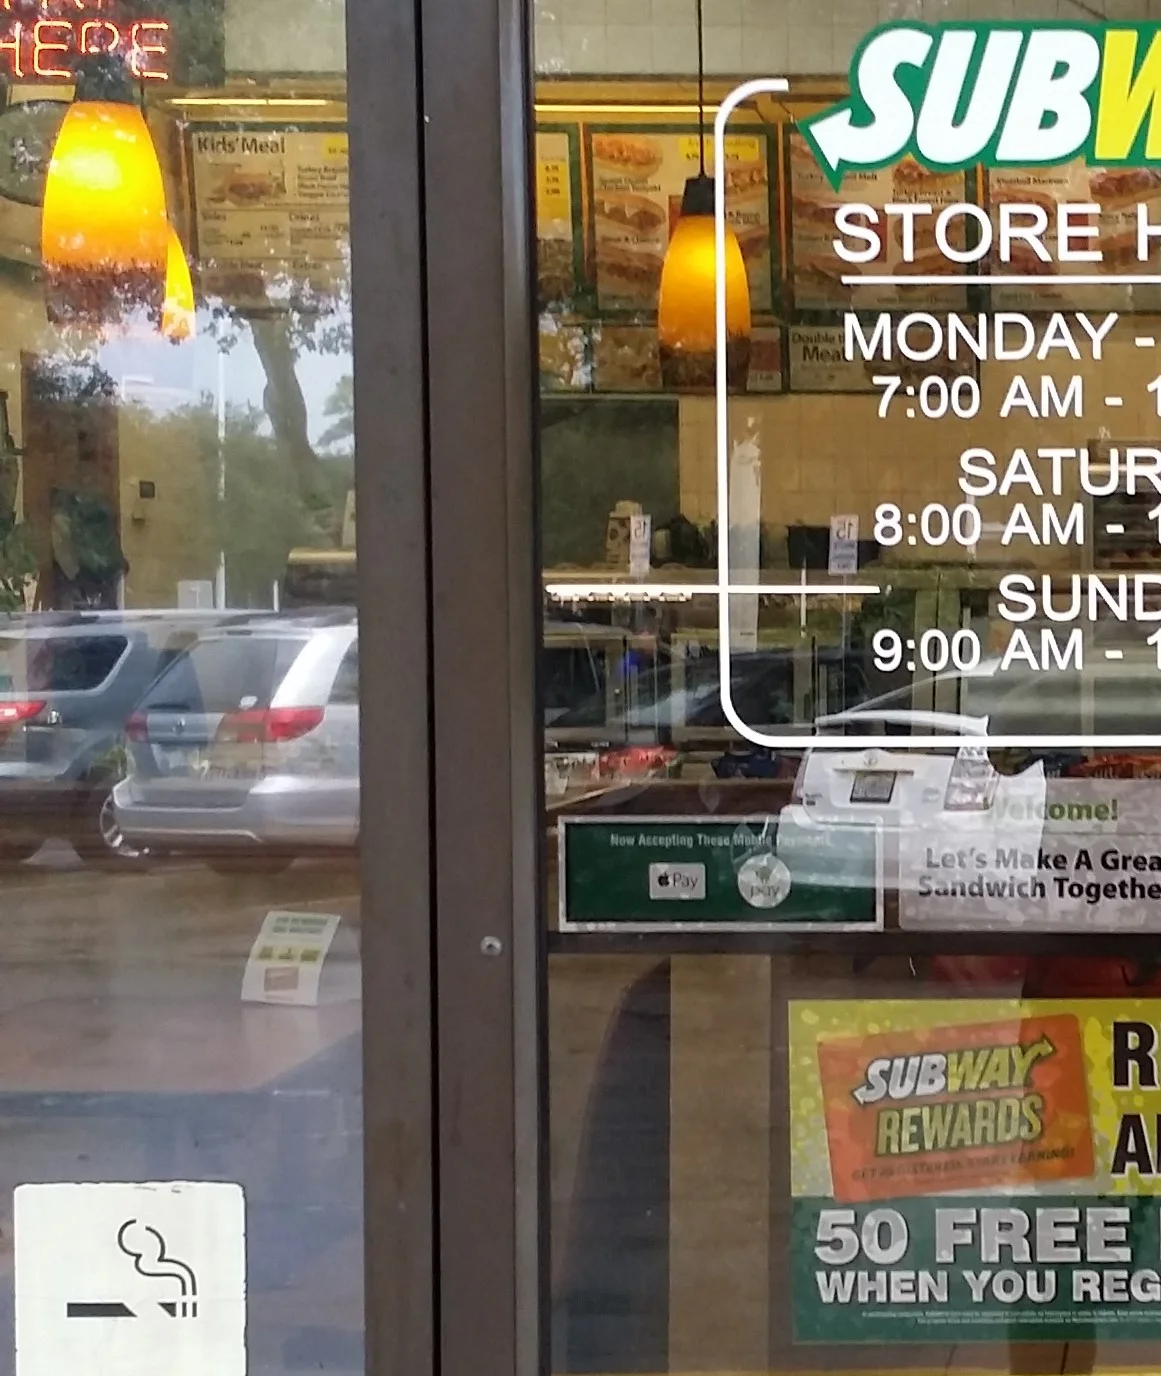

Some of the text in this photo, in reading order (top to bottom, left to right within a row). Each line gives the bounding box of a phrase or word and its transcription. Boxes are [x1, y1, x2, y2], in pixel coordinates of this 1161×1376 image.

[241, 133, 286, 155] Meal
[833, 202, 1103, 262] STORE
[792, 332, 834, 345] Double
[843, 313, 1118, 361] MONDAY
[1135, 337, 1155, 347] -
[872, 375, 981, 418] 7:00
[1000, 375, 1084, 418] AM
[1105, 396, 1122, 405] -
[873, 502, 983, 546] 8:00
[1001, 502, 1084, 545] AM
[1106, 524, 1124, 533] -
[872, 627, 982, 672] 9:00
[1001, 628, 1084, 671] AM
[1105, 650, 1123, 659] -
[610, 833, 635, 847] Now
[638, 833, 694, 849] Accepting
[698, 833, 731, 848] These
[925, 847, 988, 870] Let's
[995, 847, 1068, 871] Make
[1074, 849, 1094, 871] A
[672, 873, 699, 891] Pay
[918, 876, 1047, 899] Sandwich
[852, 1035, 1056, 1105] SUBWAY
[875, 1094, 1045, 1157] REWARDS
[813, 1206, 910, 1266] 50
[934, 1206, 1132, 1265] FREE
[815, 1269, 949, 1304] WHEN
[962, 1269, 1057, 1303] YOU
